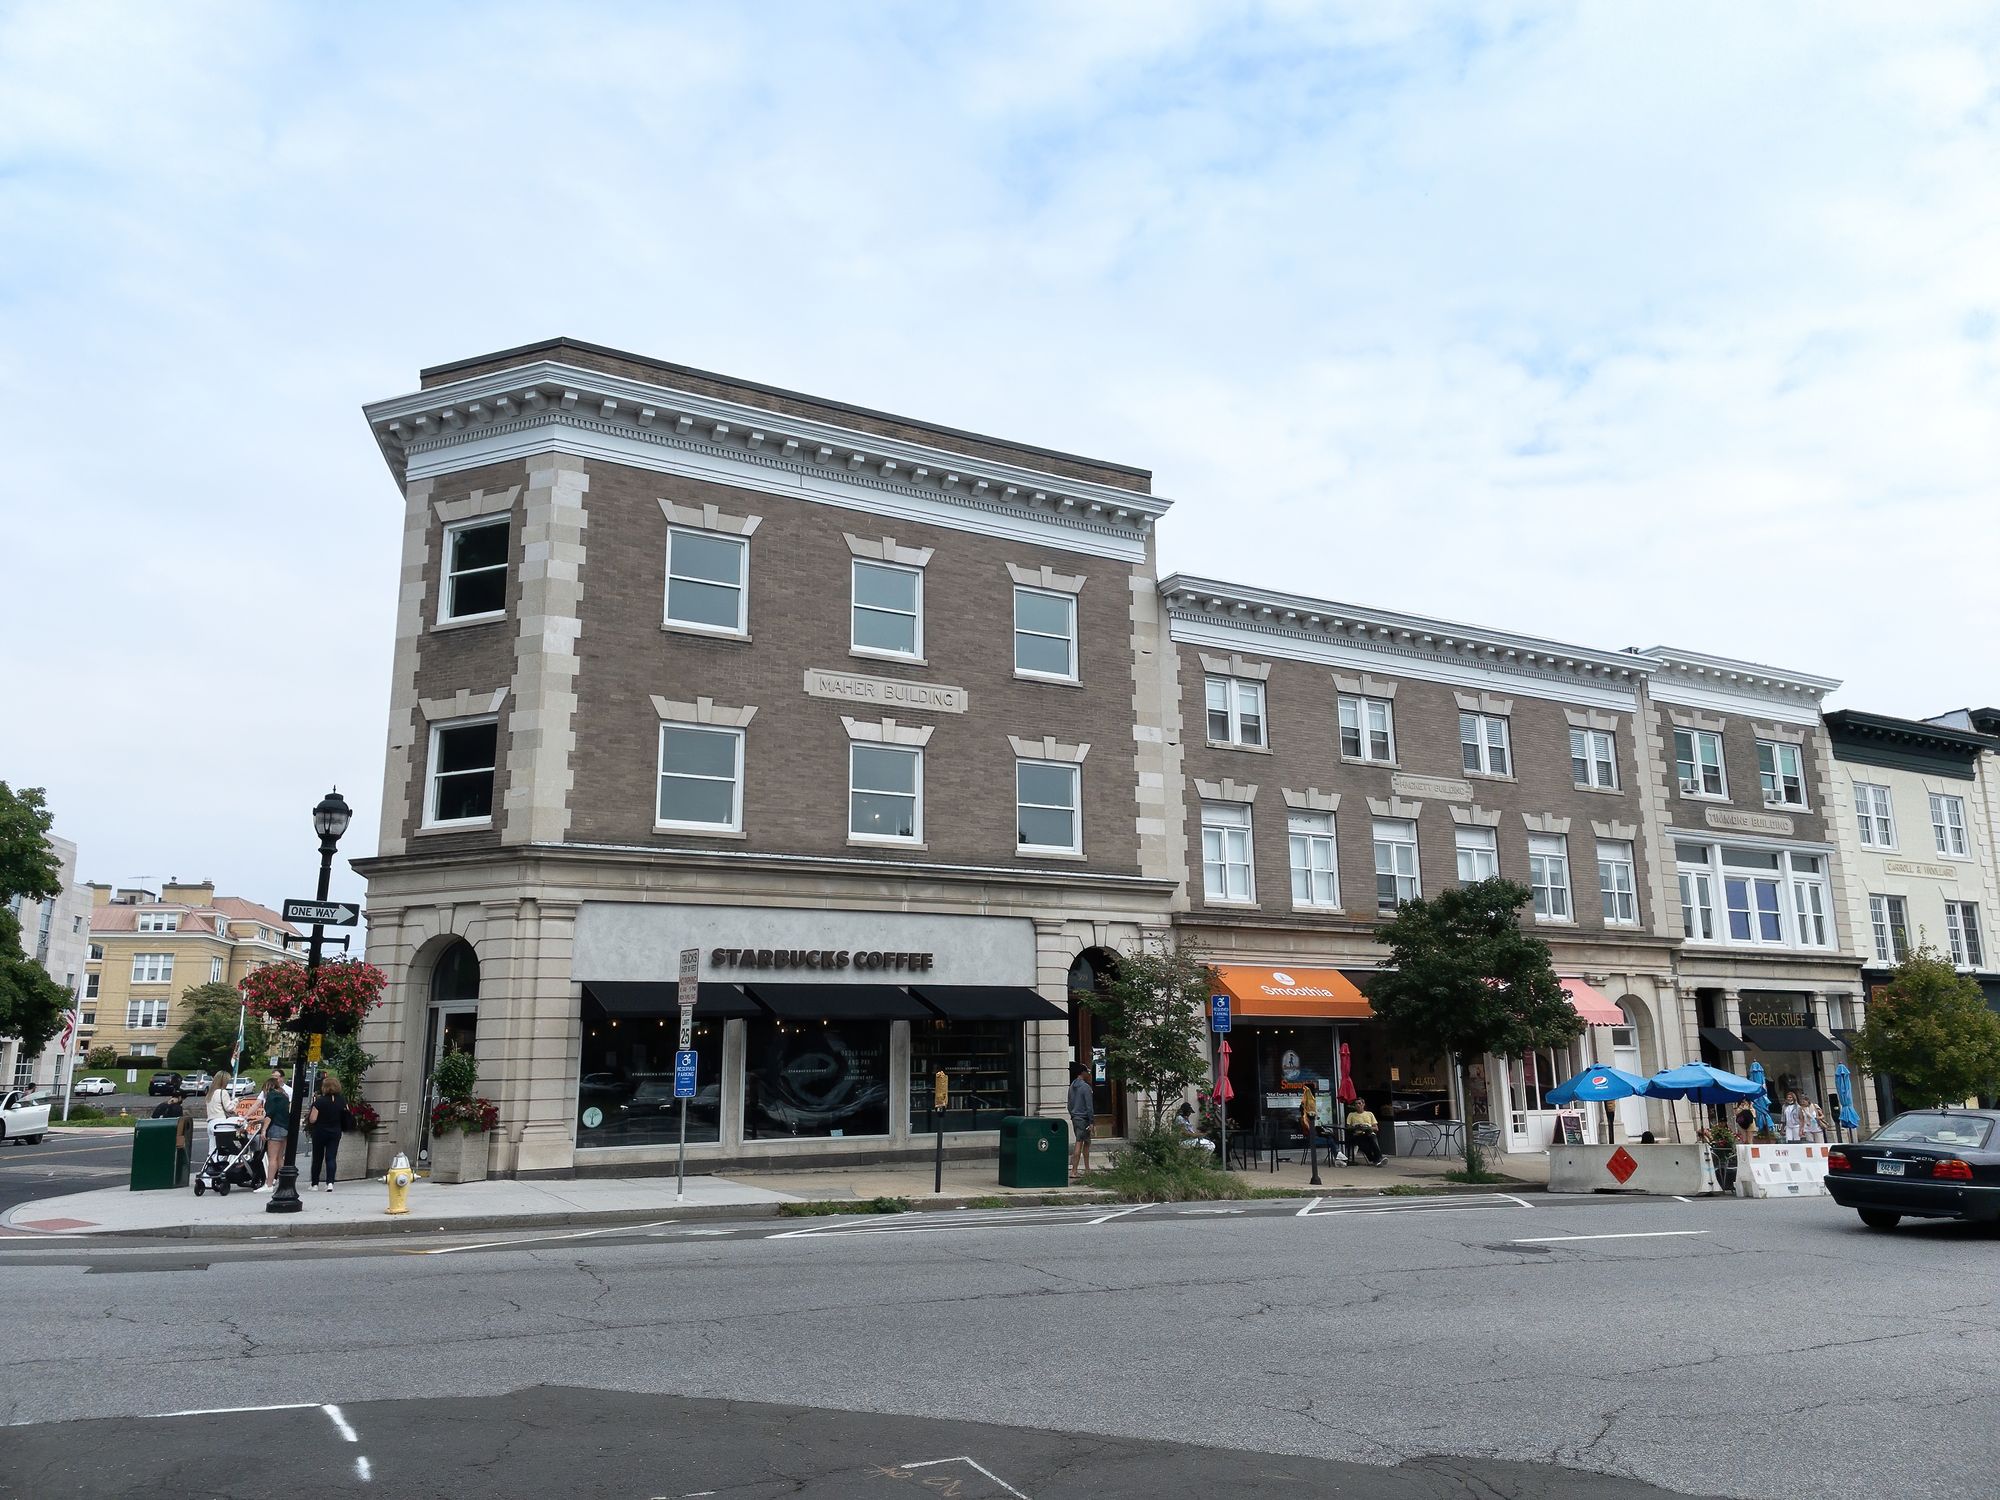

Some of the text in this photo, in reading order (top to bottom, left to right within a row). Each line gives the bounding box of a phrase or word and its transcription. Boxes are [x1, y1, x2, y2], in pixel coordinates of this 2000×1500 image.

[819, 676, 954, 706] MAHER BUILDING
[1434, 784, 1465, 795] BUILDING
[1708, 812, 1789, 831] TIMMONS BUILDING
[291, 906, 337, 918] ONE WAY
[681, 952, 698, 964] TRUCKS
[711, 948, 934, 971] STARBUCKS COFFEE
[1260, 985, 1334, 997] Smoothia
[1749, 1012, 1805, 1026] GREAT STUFF
[681, 1028, 690, 1044] 25
